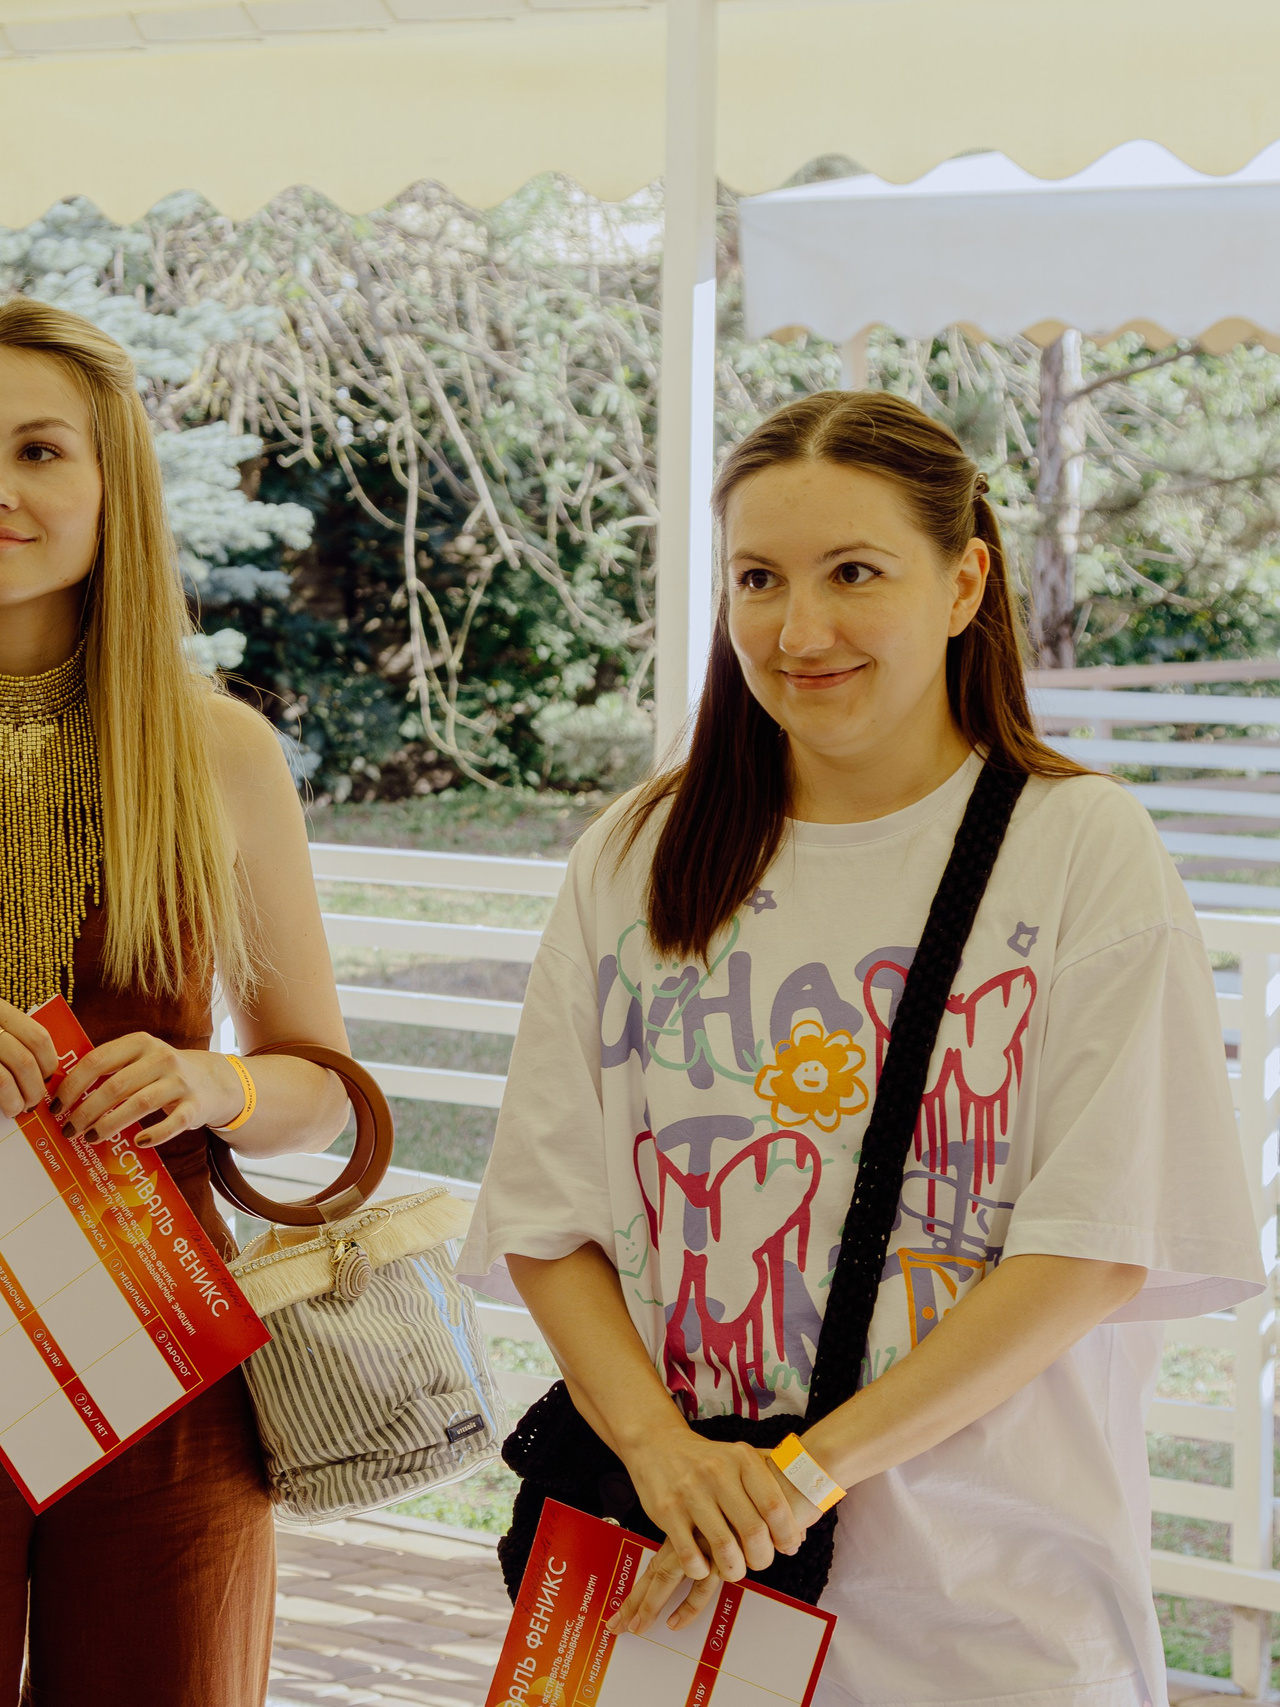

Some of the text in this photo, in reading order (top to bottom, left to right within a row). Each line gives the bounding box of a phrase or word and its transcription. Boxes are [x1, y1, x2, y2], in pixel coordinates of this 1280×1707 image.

[42, 1149, 60, 1172] КЛИП
[86, 1166, 115, 1206] МАРШРУТУ
[76, 1204, 108, 1250] РАСКРАСКА
[110, 1204, 119, 1213] И
[105, 1180, 117, 1192] НА
[111, 1190, 134, 1219] ЛЕТНИЙ
[128, 1218, 159, 1261] ФЕСТИВАЛЬ
[153, 1259, 178, 1293] ФЕНИКС,
[113, 1212, 140, 1248] ПОЛУЧИТЕ
[116, 1270, 150, 1317] МЕДИТАЦИЯ
[135, 1246, 174, 1304] НЕЗАБЫВАЕМЫЕ
[167, 1233, 231, 1319] ФЕНИКС
[170, 1302, 196, 1337] ЭМОЦИИ!
[41, 1340, 52, 1353] НА
[47, 1351, 62, 1369] ЛБУ
[162, 1341, 191, 1379] ТАРОЛОГ
[81, 1404, 94, 1418] ДА
[93, 1421, 108, 1438] НЕТ
[614, 1553, 634, 1596] ТАРОЛОГ
[522, 1555, 568, 1651] ФЕНИКС
[715, 1623, 726, 1636] ДА
[722, 1598, 733, 1614] НЕТ
[558, 1613, 586, 1680] НЕЗАБЫВАЕМЫЕ
[579, 1573, 599, 1613] ЭМОЦИИ!
[540, 1617, 575, 1705] ФЕСТИВАЛЬ ФЕНИКС,
[587, 1628, 611, 1683] МЕДИТАЦИЯ
[694, 1682, 707, 1702] ЛБУ
